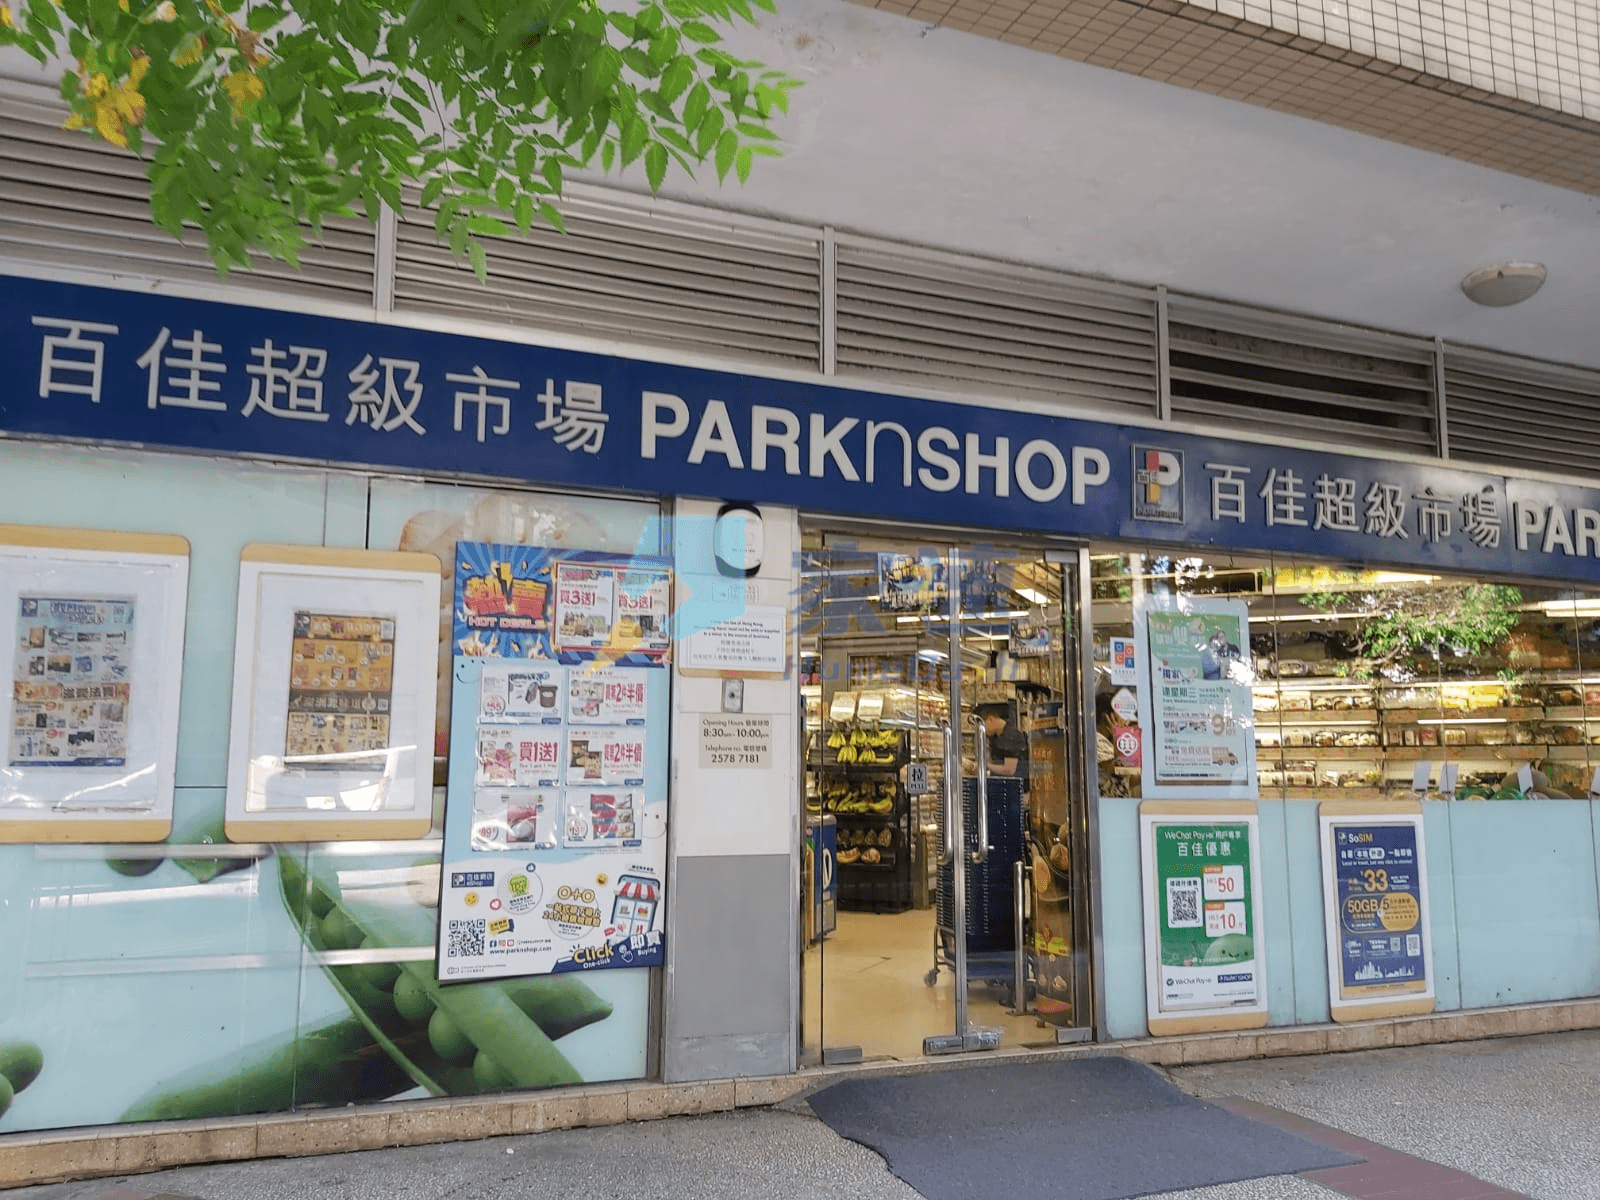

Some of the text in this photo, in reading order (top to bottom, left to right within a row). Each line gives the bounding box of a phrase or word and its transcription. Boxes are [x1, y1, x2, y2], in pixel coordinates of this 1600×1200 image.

[31, 315, 610, 455] 百佳超級市場
[641, 391, 1111, 505] PARKnSHOP
[1204, 463, 1503, 548] 百佳超級市場
[702, 719, 727, 727] Opening
[520, 741, 558, 763] 買1送1
[705, 744, 732, 753] Telephone
[711, 754, 759, 763] 2578 7181
[1164, 831, 1192, 840] WeChat
[1193, 831, 1205, 841] Pay
[1177, 841, 1231, 857] 百佳優惠
[573, 943, 615, 964] Click
